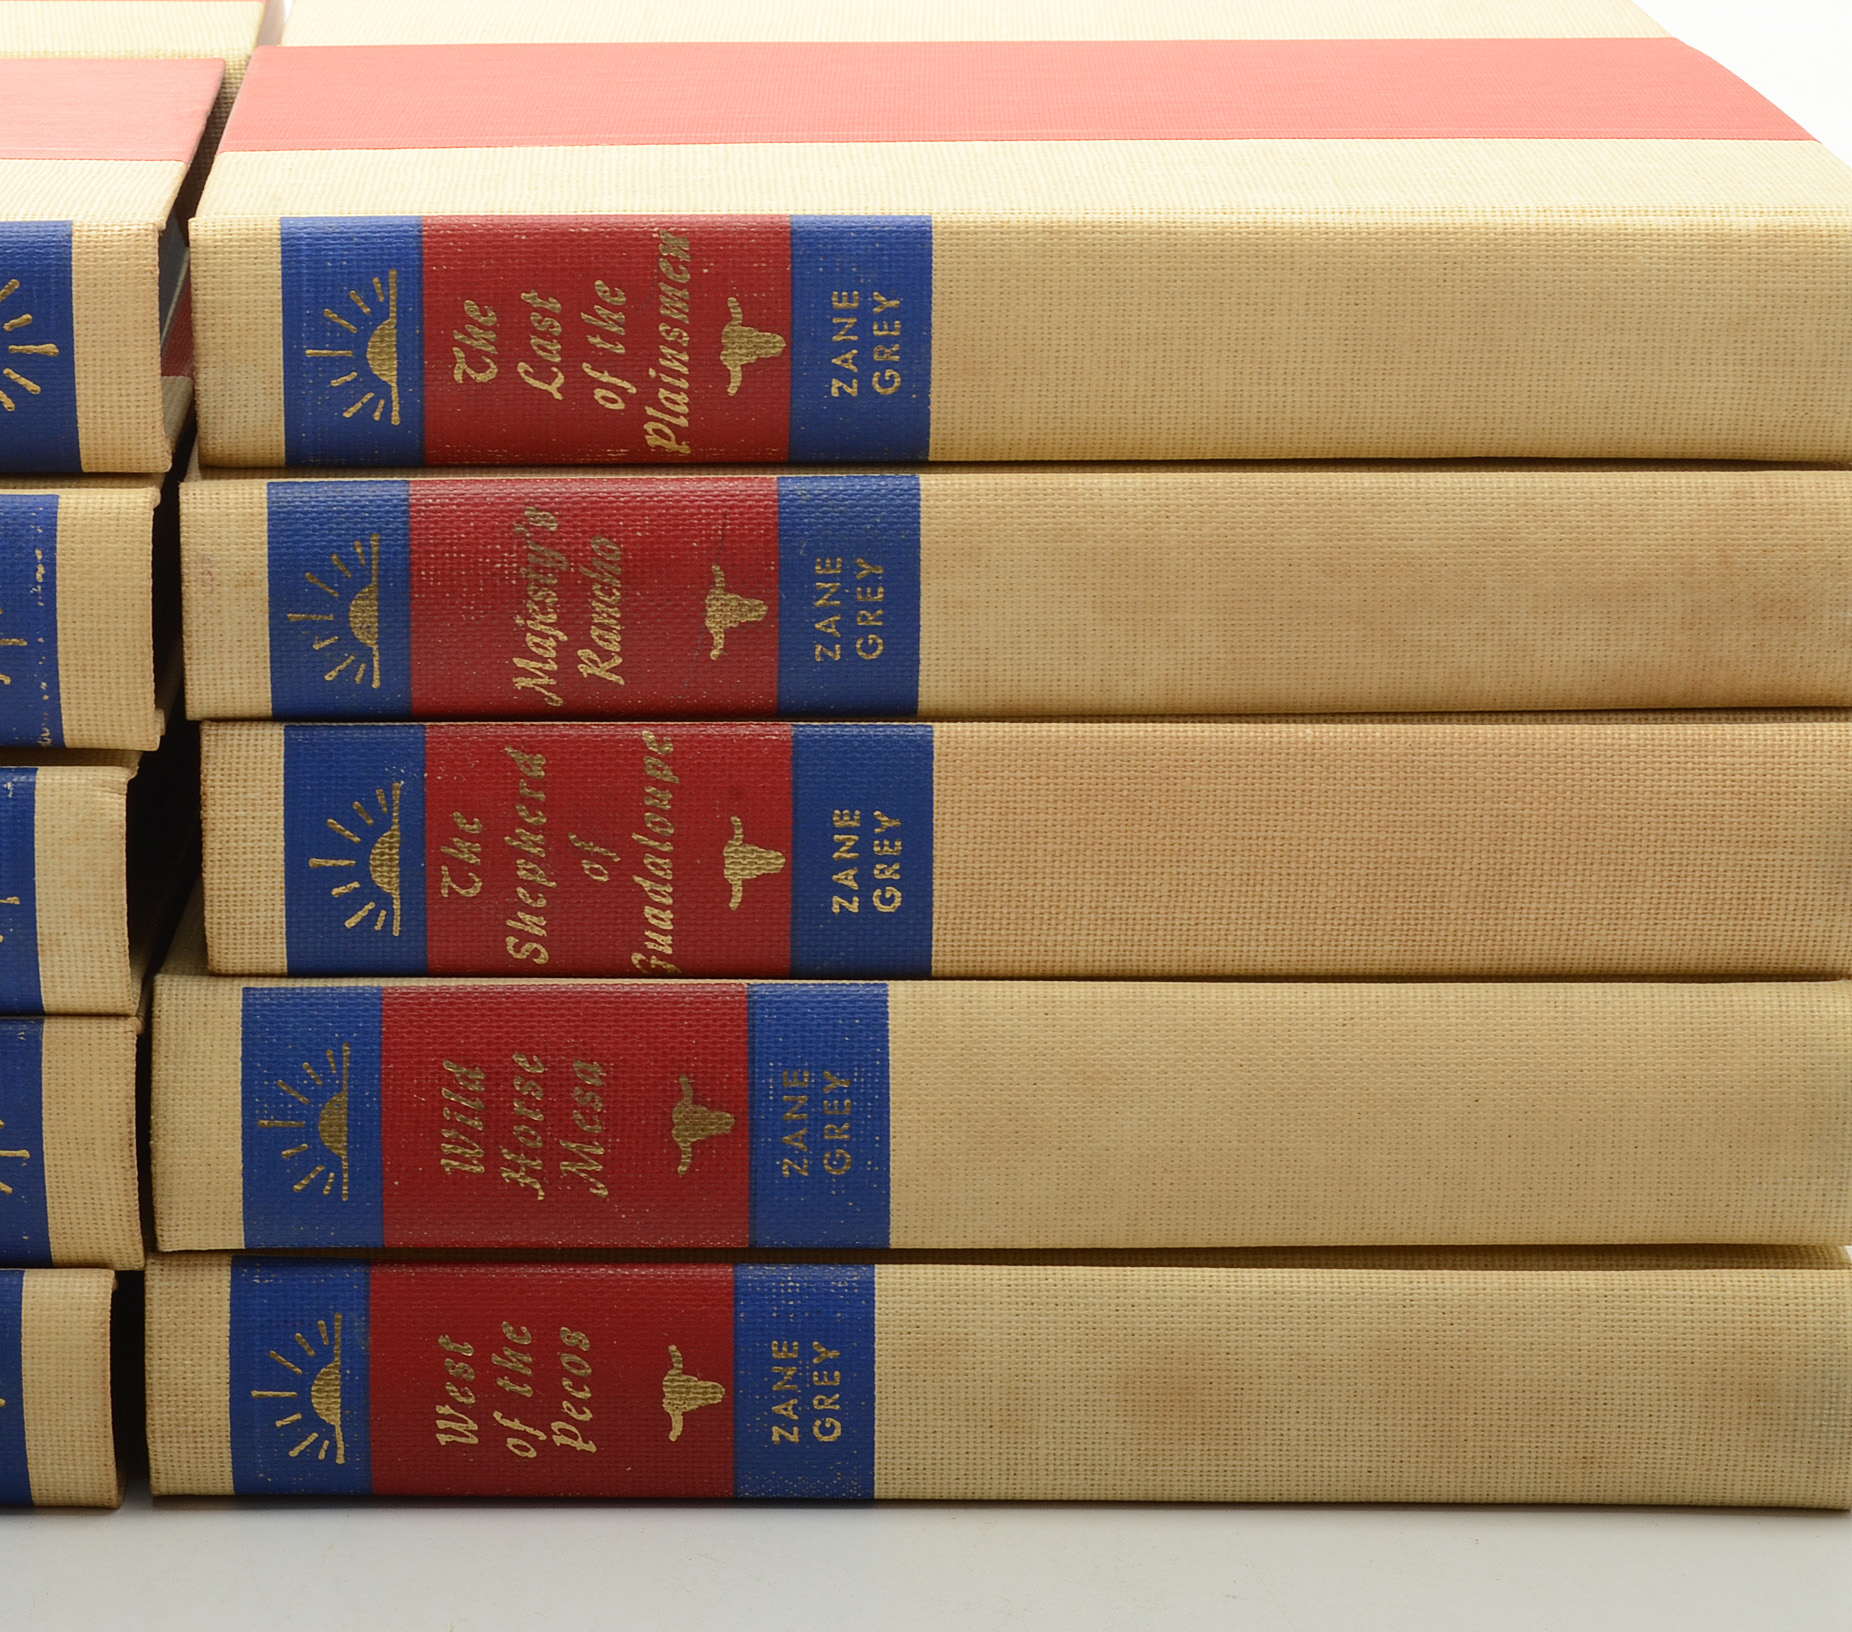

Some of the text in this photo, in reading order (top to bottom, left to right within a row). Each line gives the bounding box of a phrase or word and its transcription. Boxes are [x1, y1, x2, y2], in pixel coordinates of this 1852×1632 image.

[452, 299, 497, 384] The
[517, 289, 565, 400] Last
[581, 279, 637, 410] of the
[645, 228, 691, 455] Plainsmen
[831, 289, 859, 398] ZANE
[872, 291, 901, 395] GREY
[512, 506, 570, 707] Majesty's
[577, 535, 625, 686] Rancho
[815, 556, 843, 662] ZANE
[856, 556, 884, 660] GREY
[441, 811, 483, 898] The
[504, 745, 557, 965] Shepherd
[568, 832, 621, 883] of
[832, 808, 861, 914] ZANE
[873, 810, 902, 913] GREY
[440, 1059, 485, 1175] Wild
[500, 1052, 546, 1201] Horse
[559, 1058, 609, 1199] Mesa
[782, 1068, 809, 1178] ZANE
[822, 1070, 852, 1176] GREY
[436, 1334, 480, 1447] West
[491, 1321, 548, 1458] of the
[551, 1326, 597, 1454] Pecos
[771, 1340, 799, 1444] ZANE
[812, 1341, 842, 1443] GREY
